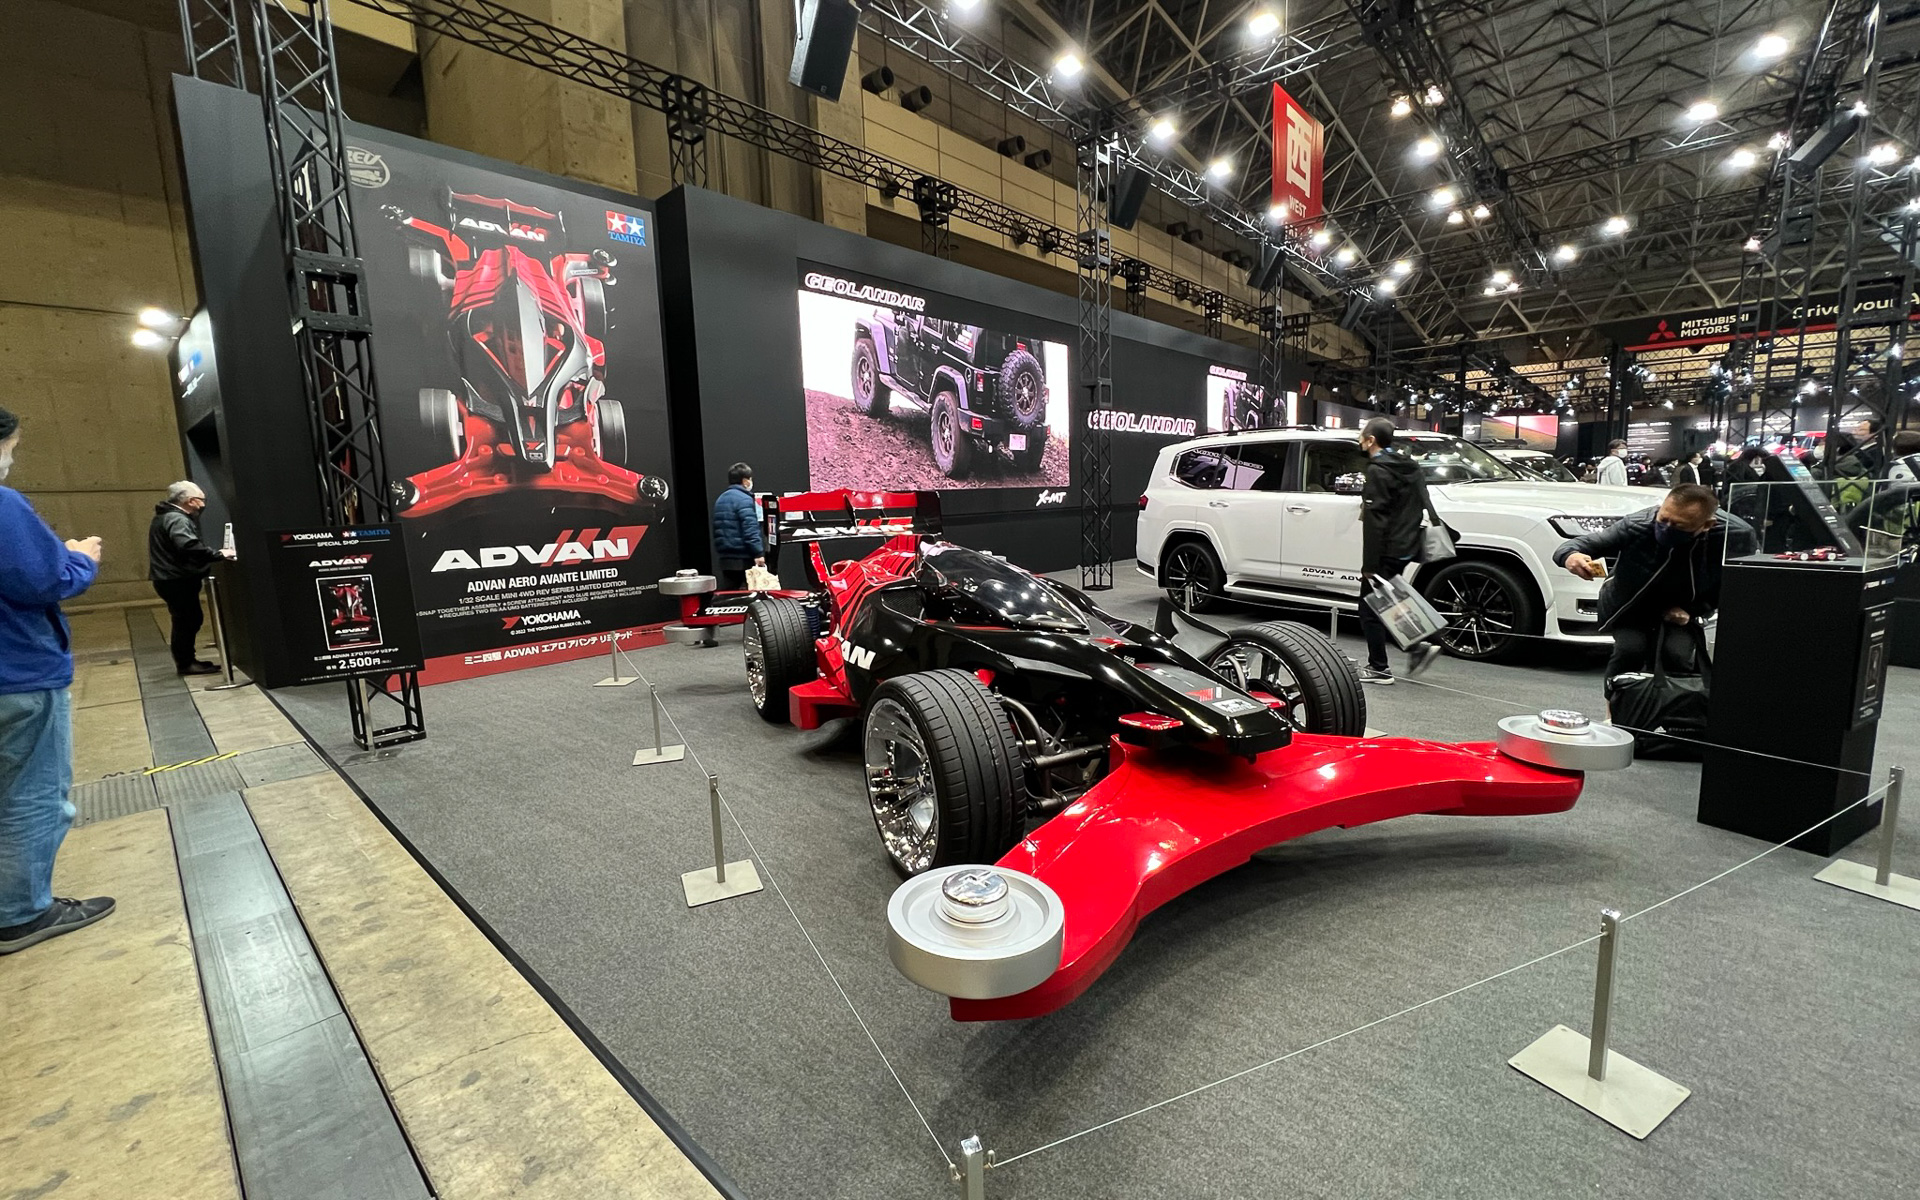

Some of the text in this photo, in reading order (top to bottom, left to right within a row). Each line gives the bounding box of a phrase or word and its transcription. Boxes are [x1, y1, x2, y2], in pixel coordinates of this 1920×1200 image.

[1286, 102, 1312, 198] 西
[1289, 195, 1307, 218] WEST
[459, 217, 545, 242] ADVAN
[607, 231, 646, 247] TAMIYA
[804, 272, 926, 312] GEOLANDAR
[1680, 325, 1730, 338] MOTORS
[292, 529, 391, 541] YOKOHAMA TAMIYA
[792, 524, 914, 537] ADVAN
[308, 557, 368, 568] ADVAN
[431, 538, 629, 573] ADVAN
[467, 567, 619, 593] ADVAN AERO AVANTE LIMITED
[1302, 567, 1335, 576] ADVAN
[458, 597, 474, 605] 1/32
[475, 594, 500, 603] SCALE
[501, 592, 518, 600] MINI
[536, 588, 551, 596] REV
[551, 585, 576, 594] SERIES
[576, 583, 602, 592] LIMITED
[602, 580, 627, 589] EDITION
[437, 606, 470, 614] TOGETHER
[471, 602, 502, 610] ASSEMBLY
[521, 609, 581, 626] YOKOHAMA
[504, 645, 540, 659] ADVAN
[541, 641, 567, 653] エアロ
[567, 636, 598, 649] アバンテ
